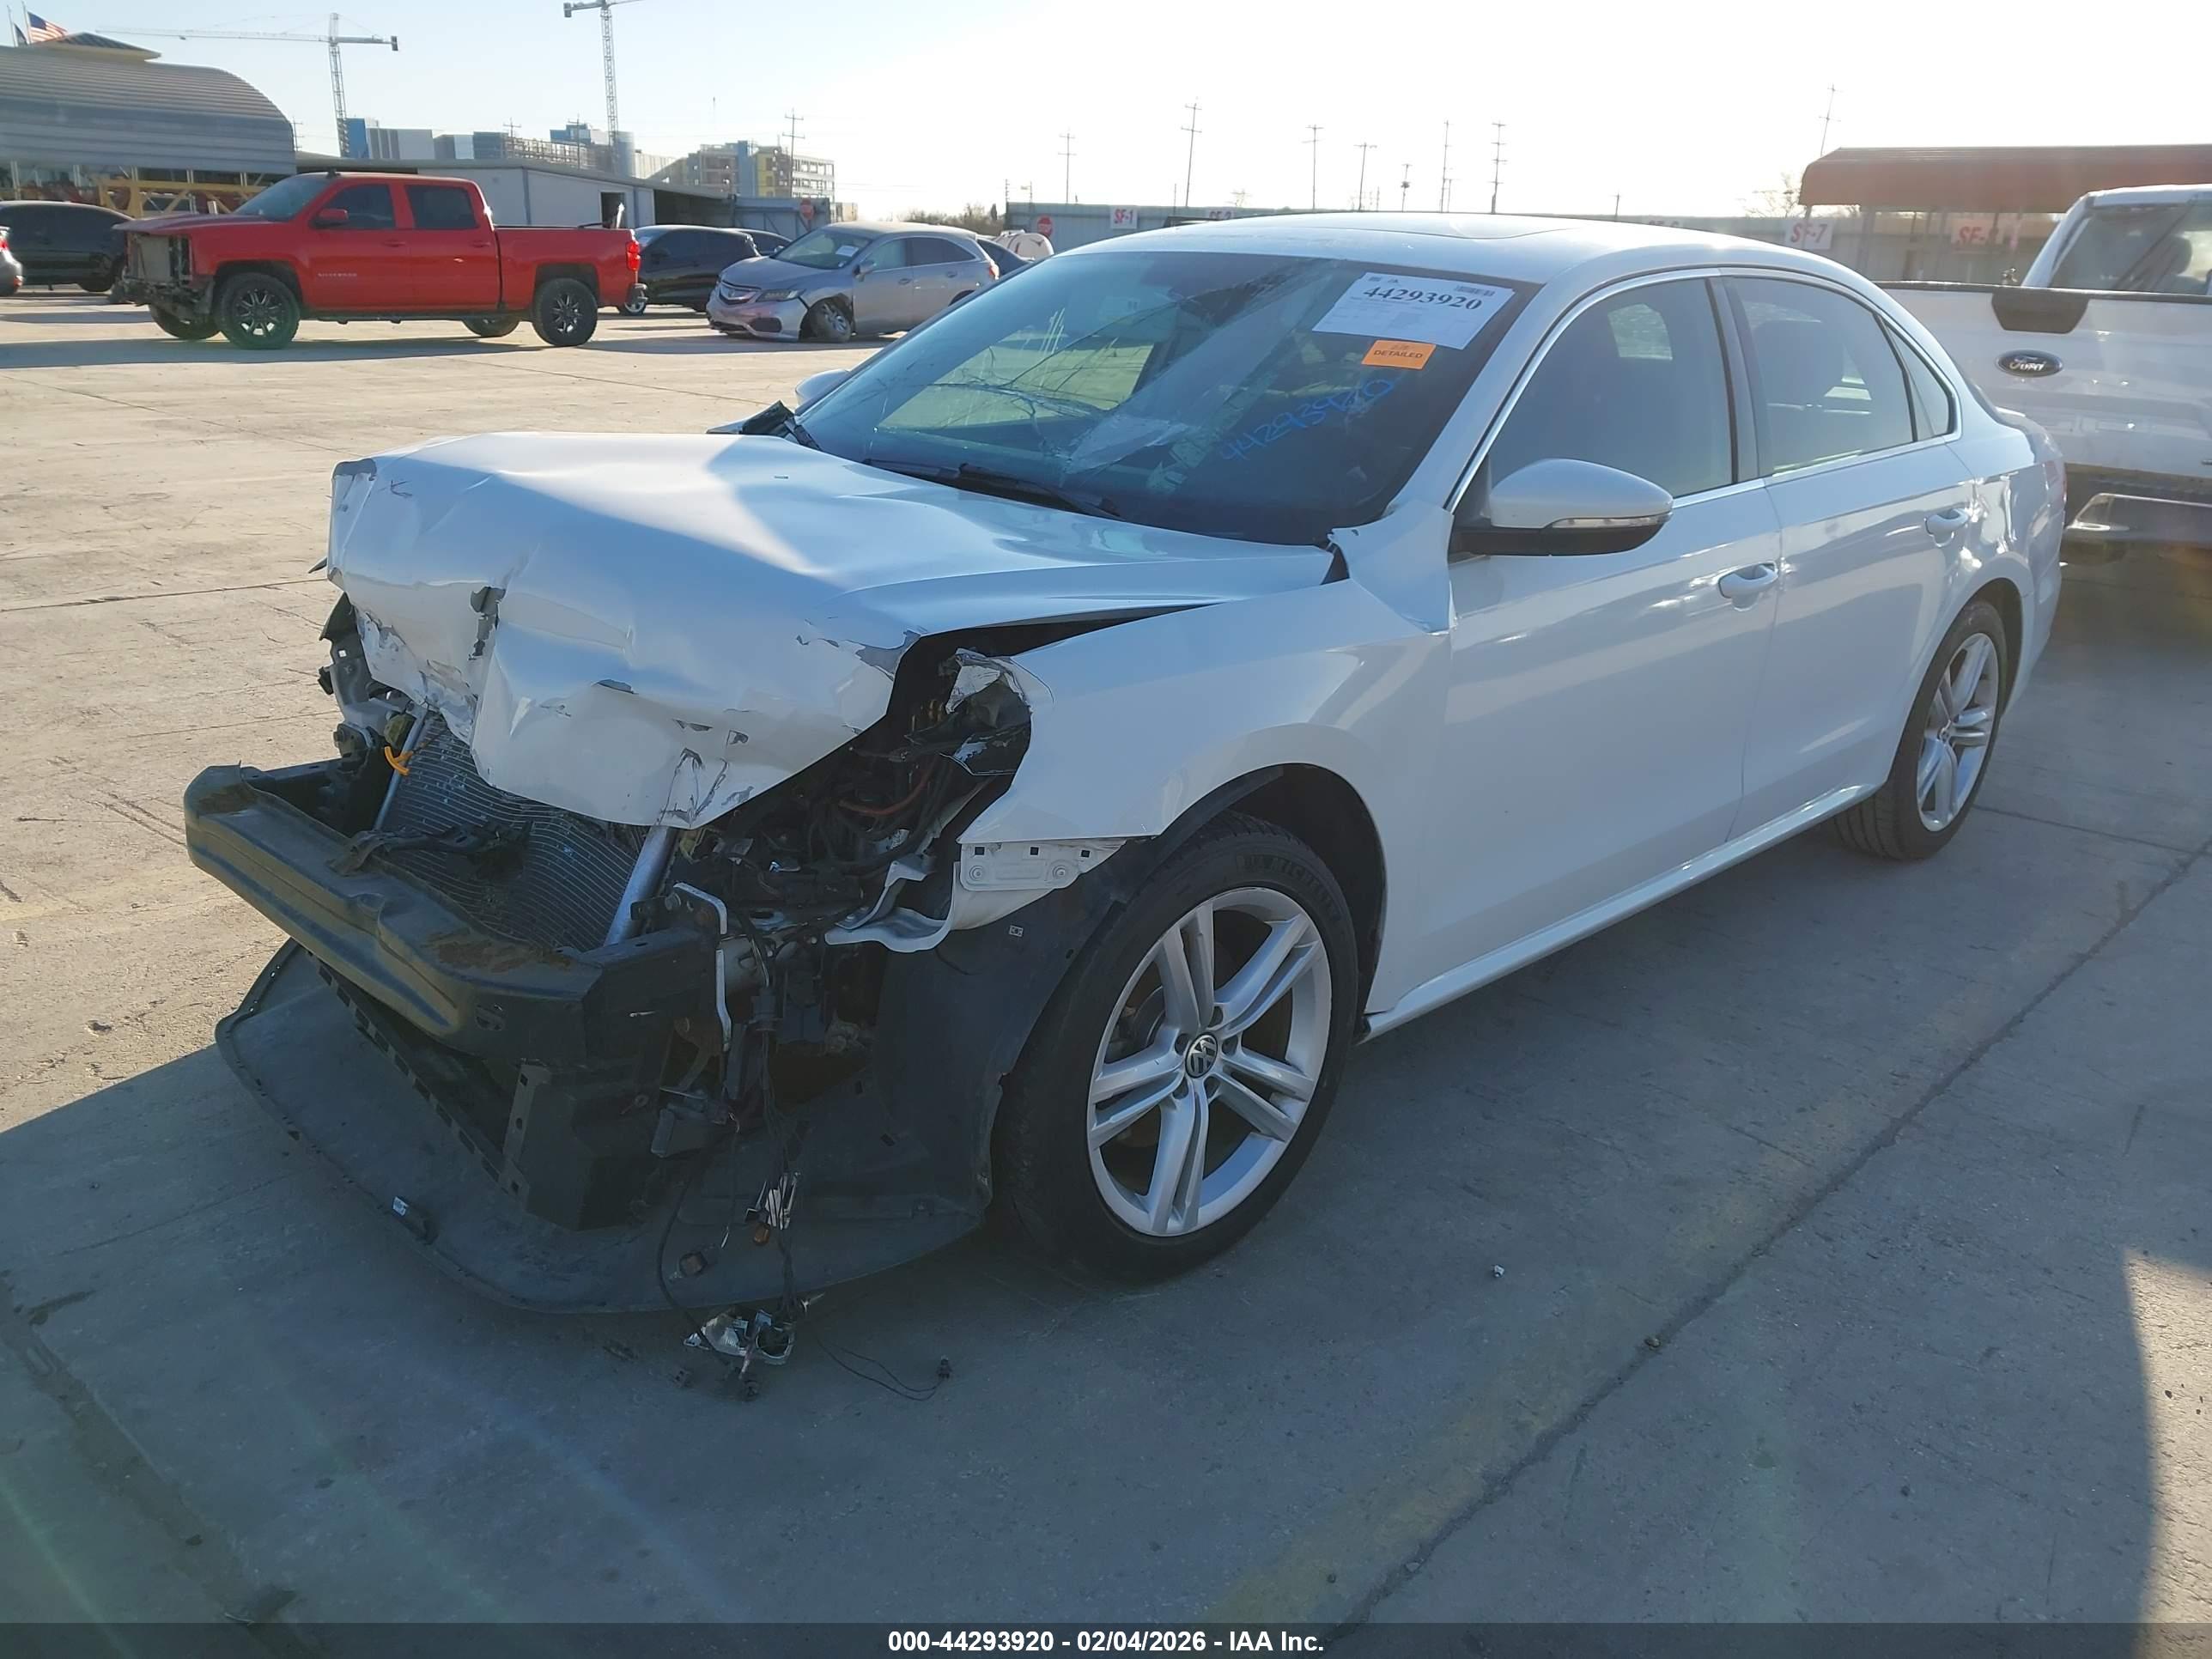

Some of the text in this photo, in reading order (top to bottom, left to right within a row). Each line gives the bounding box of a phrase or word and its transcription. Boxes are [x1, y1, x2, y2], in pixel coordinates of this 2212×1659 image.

[1114, 209, 1133, 223] SF-1
[1364, 286, 1483, 310] 44293920
[1374, 349, 1423, 358] DETAILED
